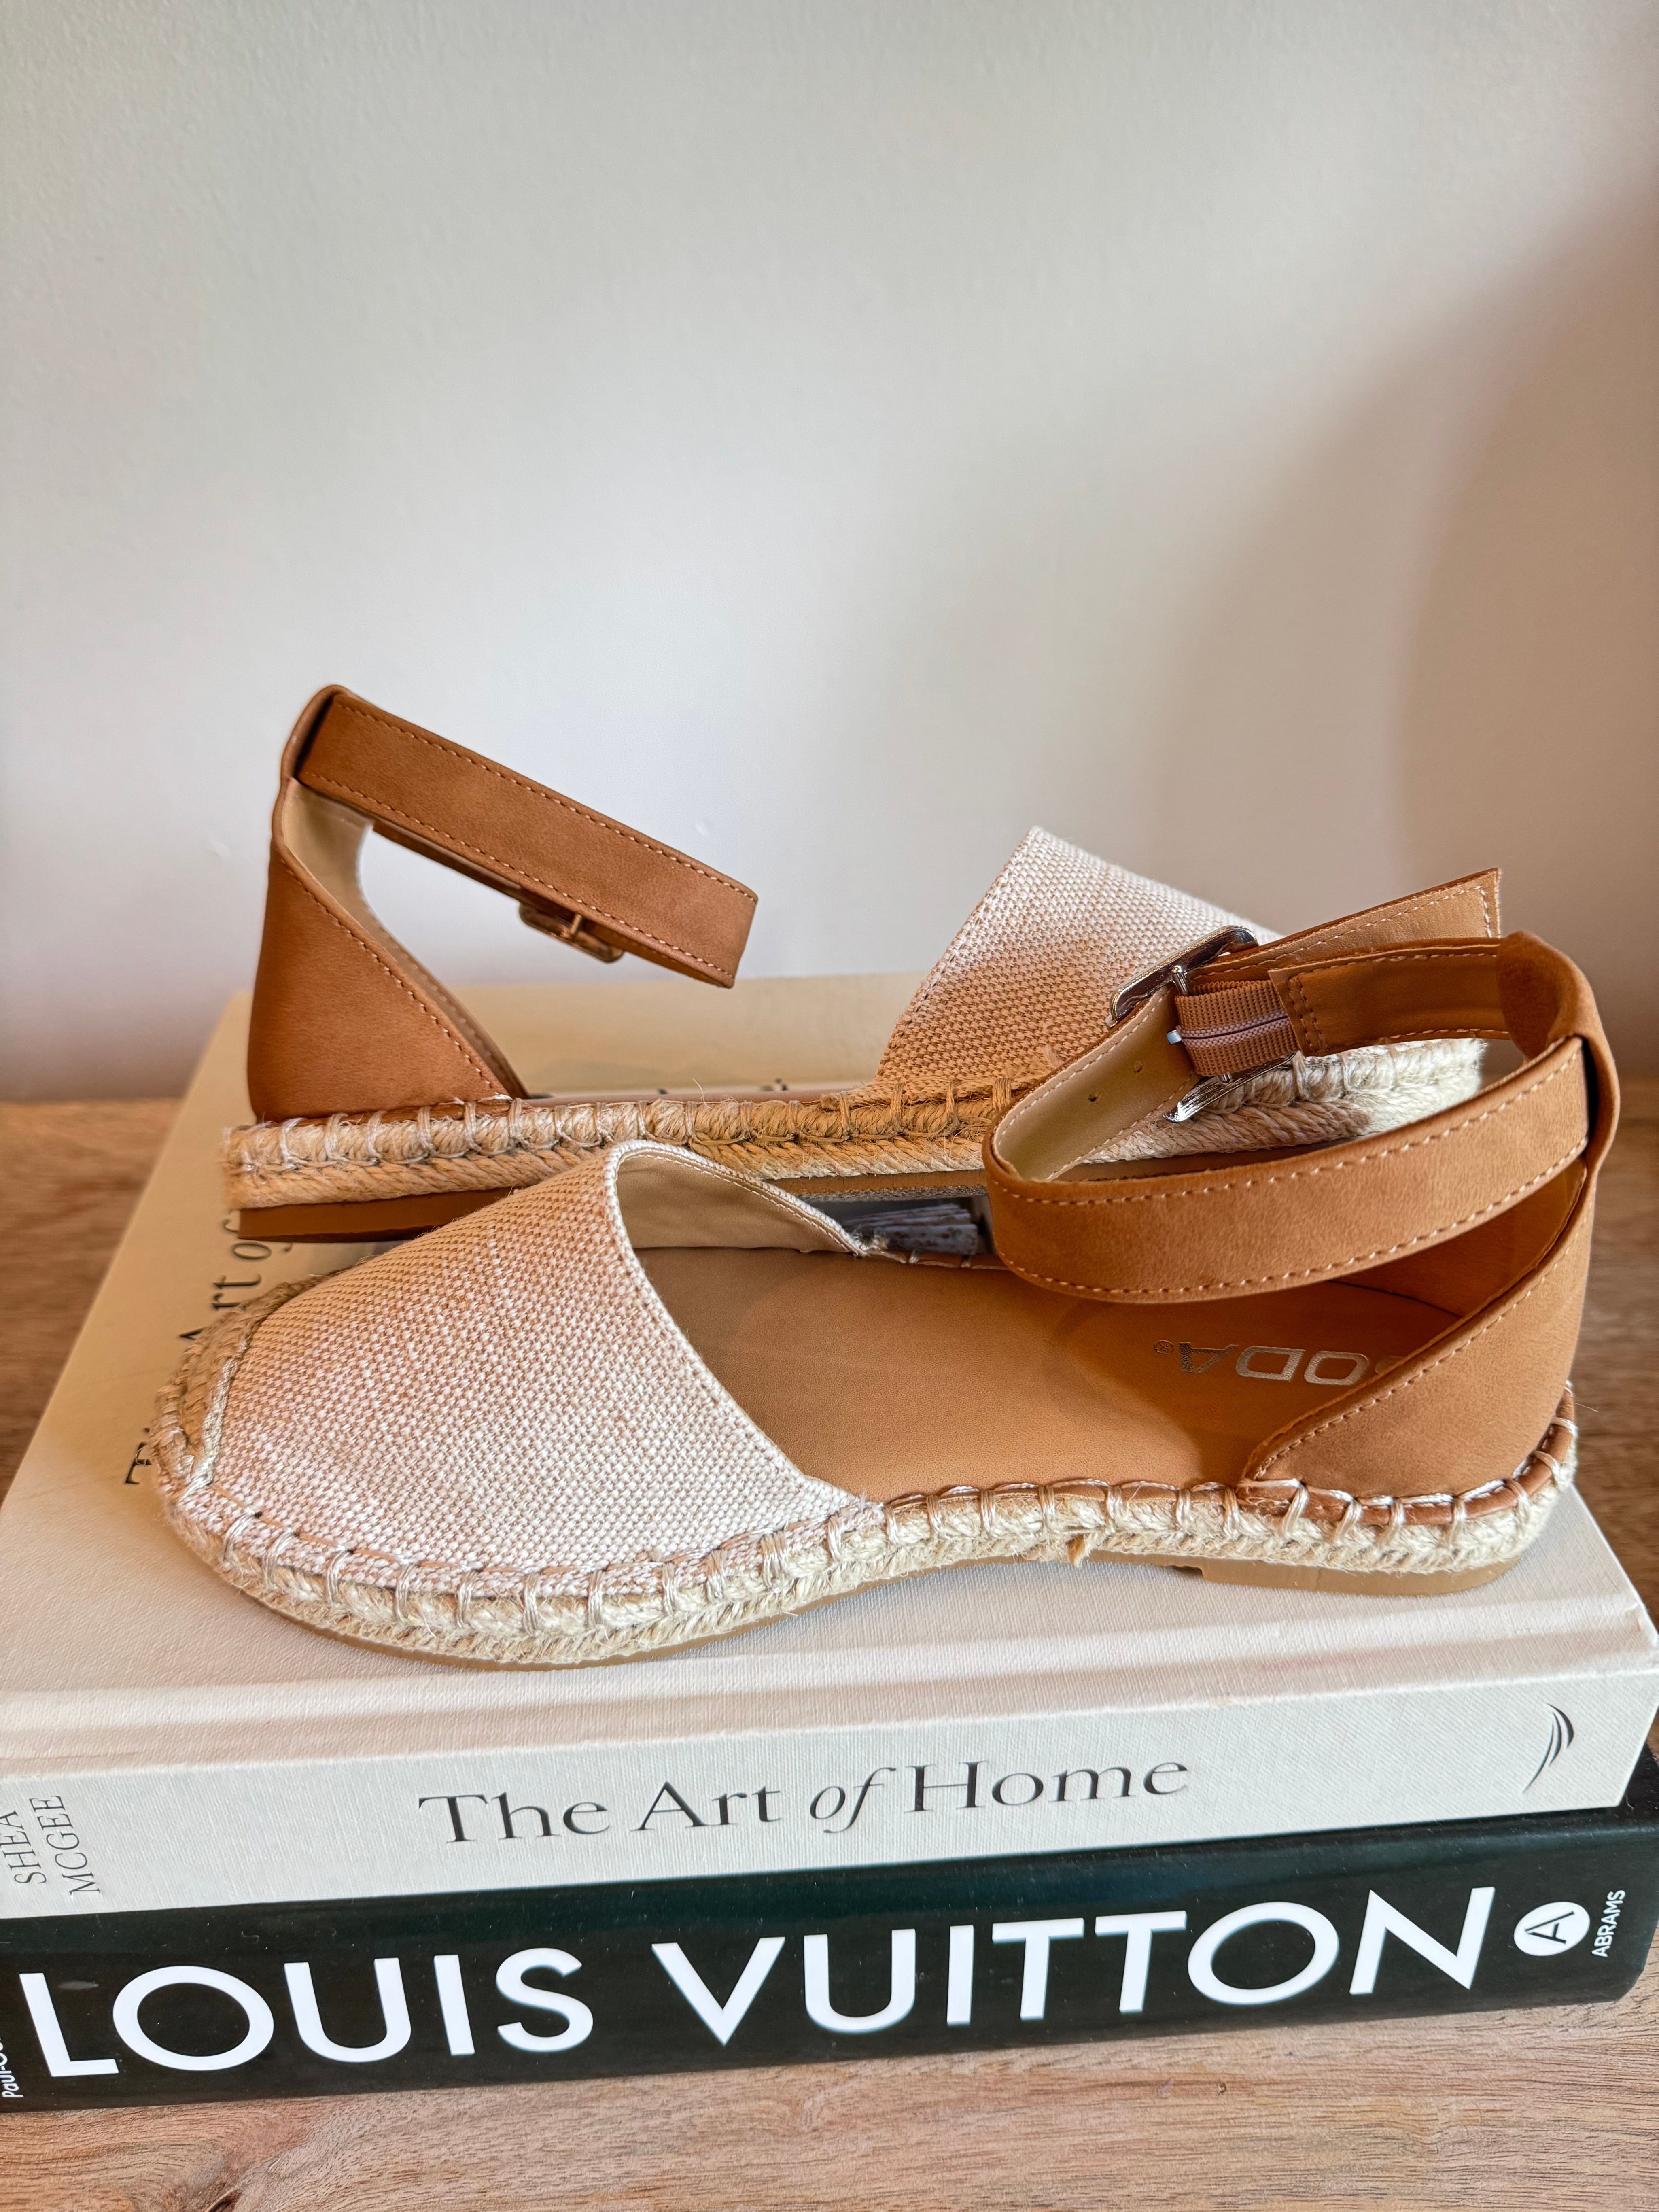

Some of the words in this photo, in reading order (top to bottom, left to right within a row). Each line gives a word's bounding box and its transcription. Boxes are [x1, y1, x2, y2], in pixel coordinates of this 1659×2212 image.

[419, 1792, 610, 1843] The
[630, 1781, 781, 1831] Art
[809, 1767, 897, 1834] of
[904, 1760, 1188, 1814] Home
[0, 1810, 47, 1884] SHEA
[29, 1795, 101, 1896] MCGEE
[1591, 1889, 1626, 1957] ABRAMS
[19, 1947, 594, 2077] LOUIS
[651, 1886, 1495, 2046] VUITTON
